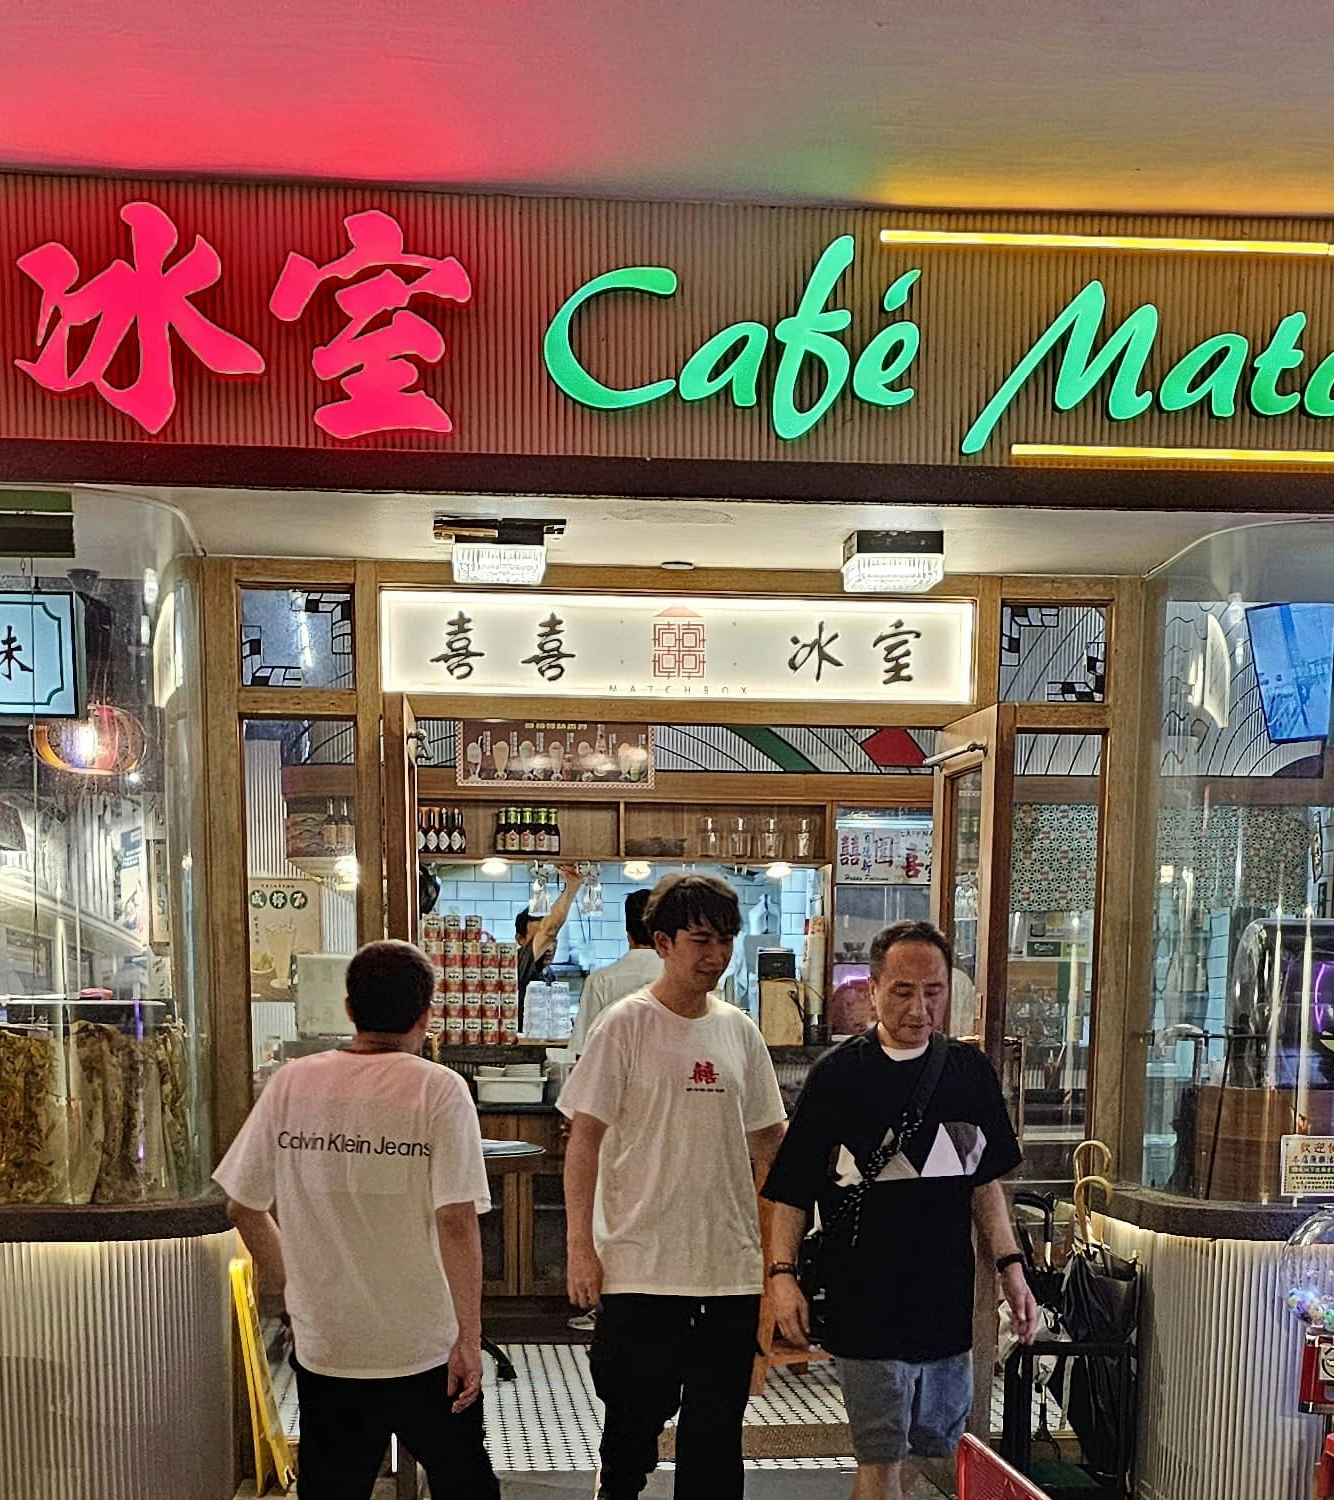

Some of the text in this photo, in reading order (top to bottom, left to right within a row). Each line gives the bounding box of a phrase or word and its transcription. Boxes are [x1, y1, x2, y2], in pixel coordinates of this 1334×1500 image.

[543, 233, 923, 440] Café
[430, 611, 922, 684] 喜喜 冰室
[277, 1130, 432, 1157] Calvin Klein Jeans
